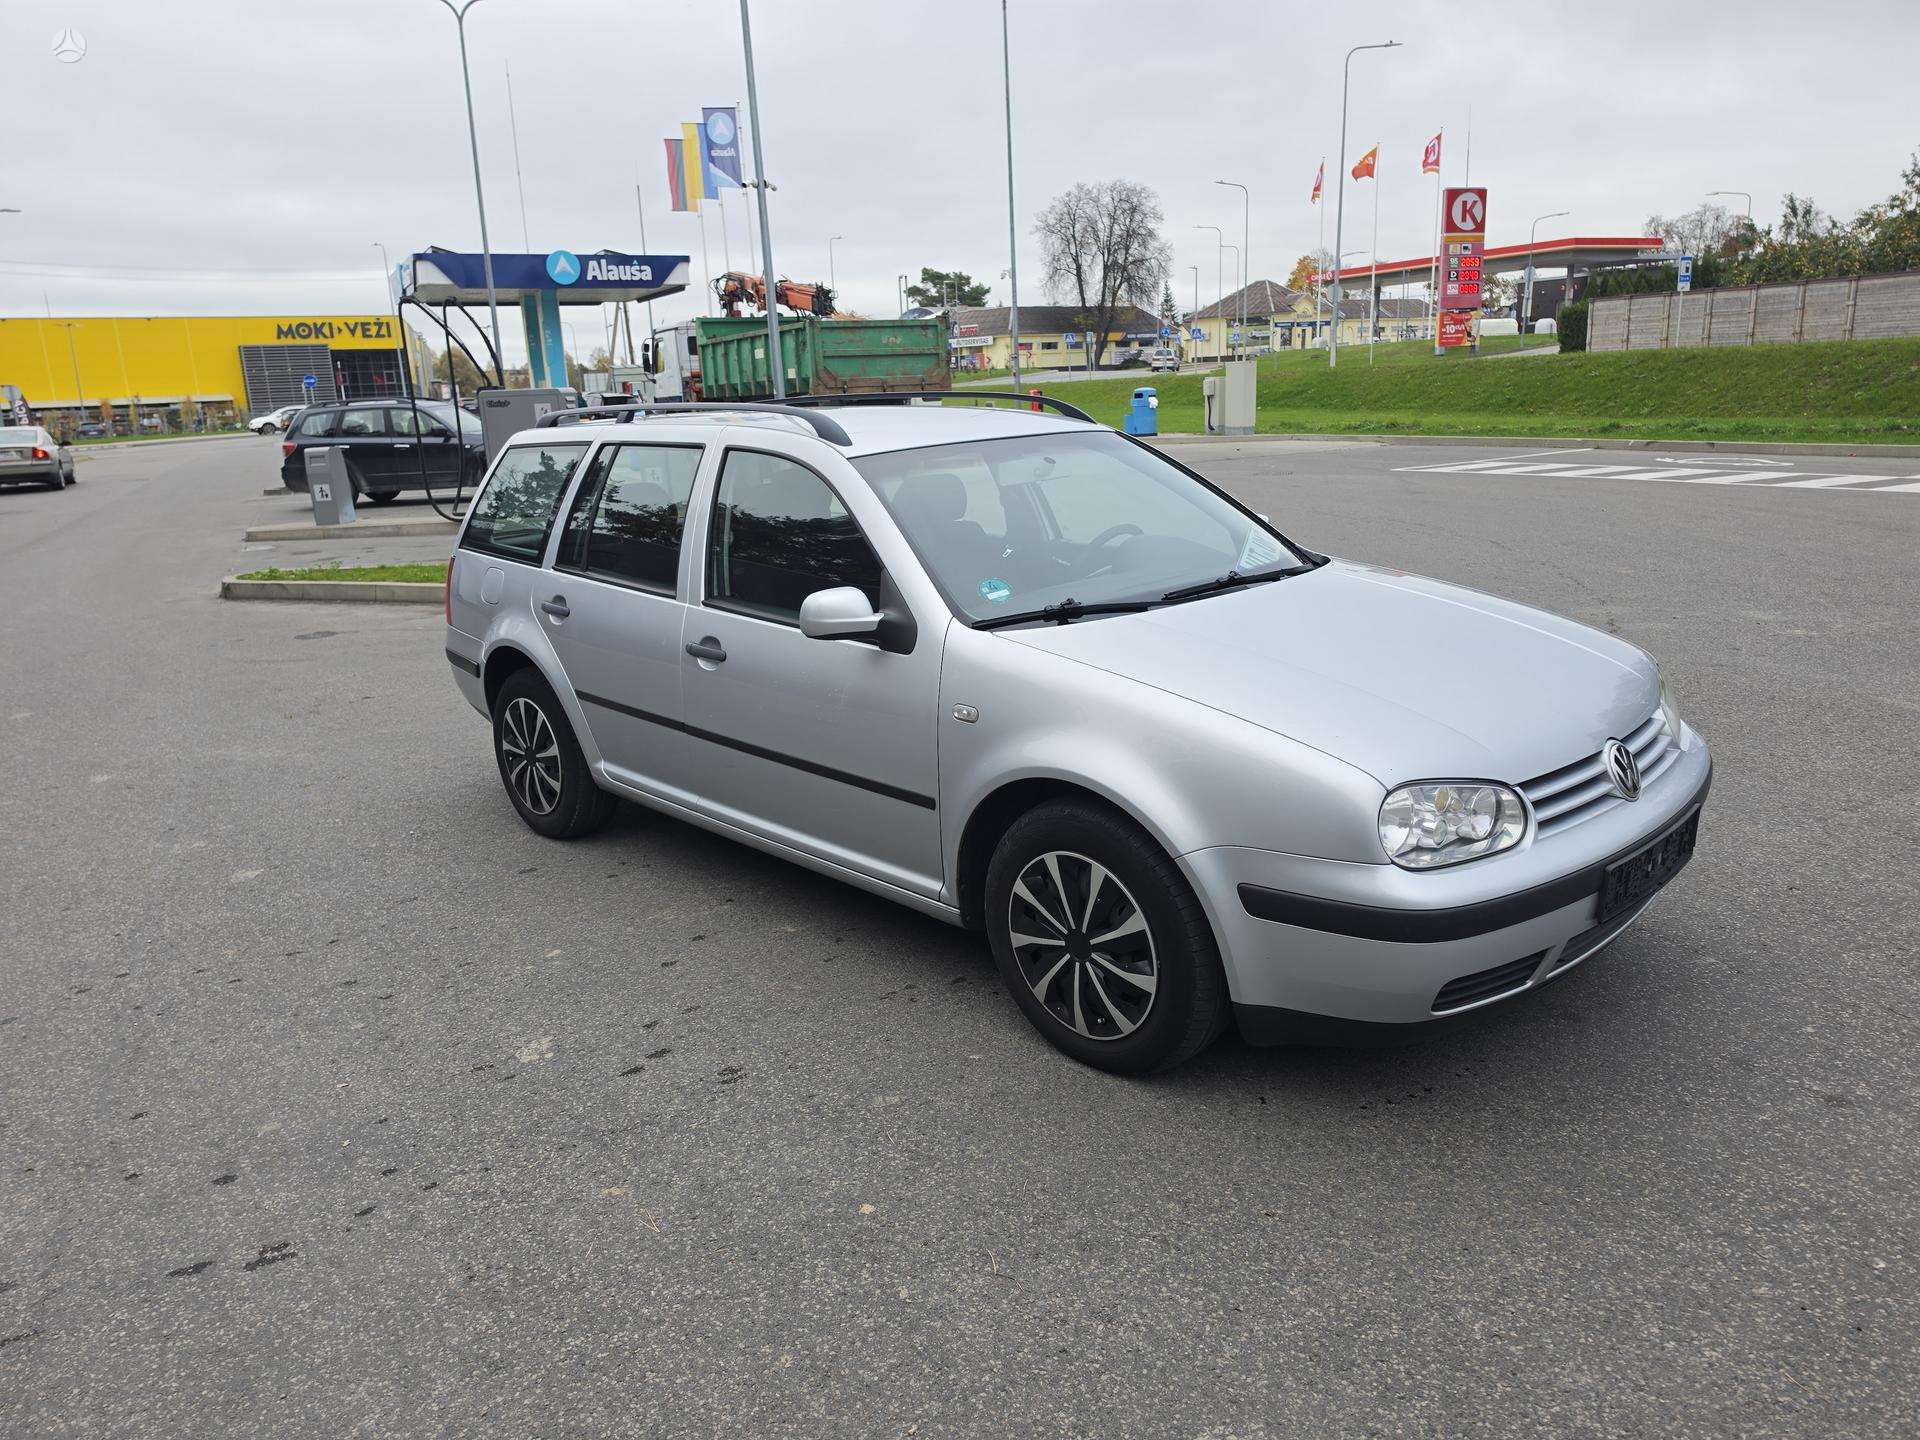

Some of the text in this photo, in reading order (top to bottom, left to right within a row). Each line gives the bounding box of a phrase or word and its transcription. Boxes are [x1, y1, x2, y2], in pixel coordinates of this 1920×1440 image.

[1461, 200, 1481, 227] K
[276, 317, 392, 340] MOKI VEŽI
